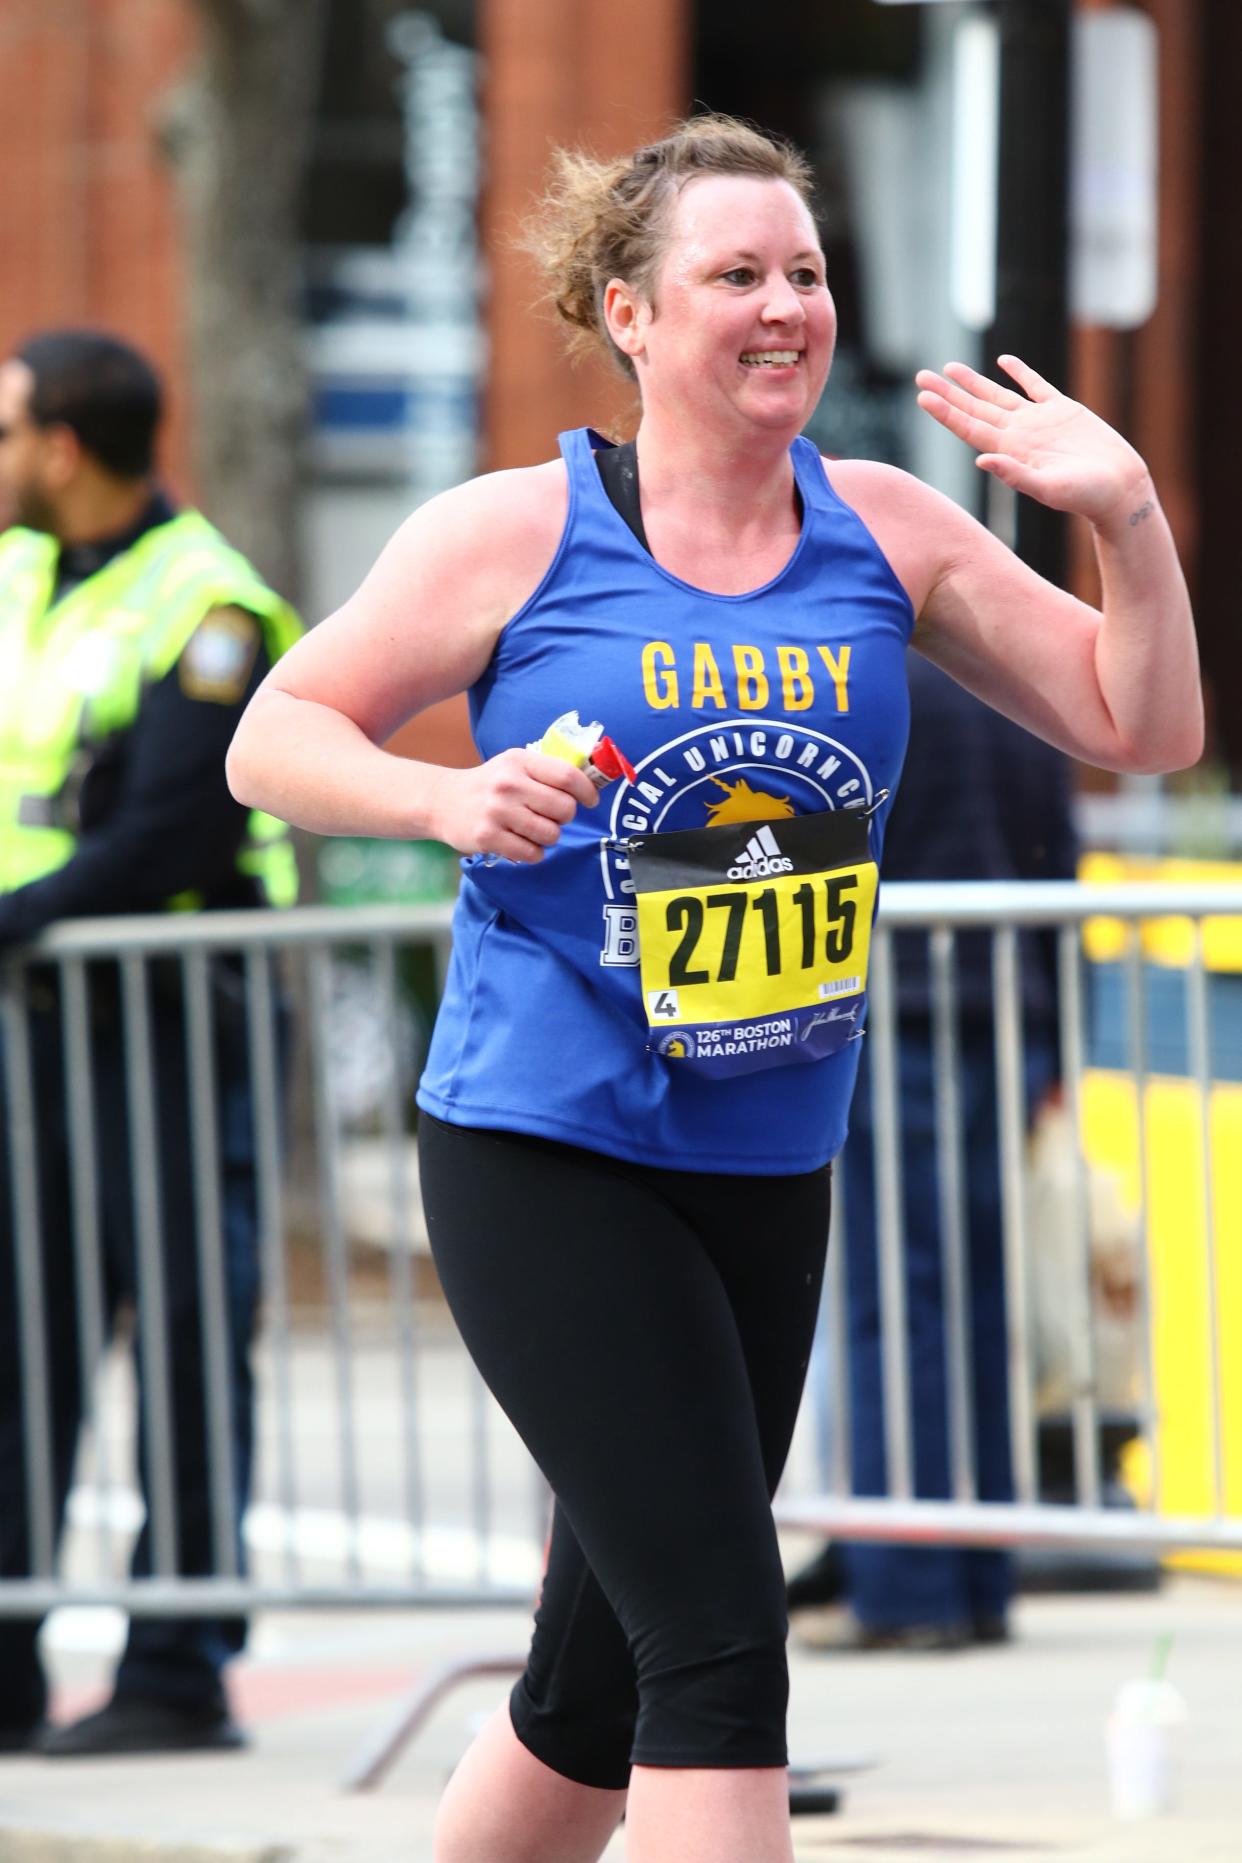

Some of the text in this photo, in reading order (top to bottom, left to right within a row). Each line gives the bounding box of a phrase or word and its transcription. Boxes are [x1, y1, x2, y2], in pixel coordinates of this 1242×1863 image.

[641, 641, 852, 712] GABBY
[683, 731, 842, 780] UNICORN
[727, 856, 794, 881] adidas
[665, 874, 858, 987] 27115
[654, 993, 677, 1017] 4
[696, 1029, 732, 1044] 126TH
[734, 1018, 791, 1040] BOSTON
[696, 1034, 793, 1058] MARATHON
